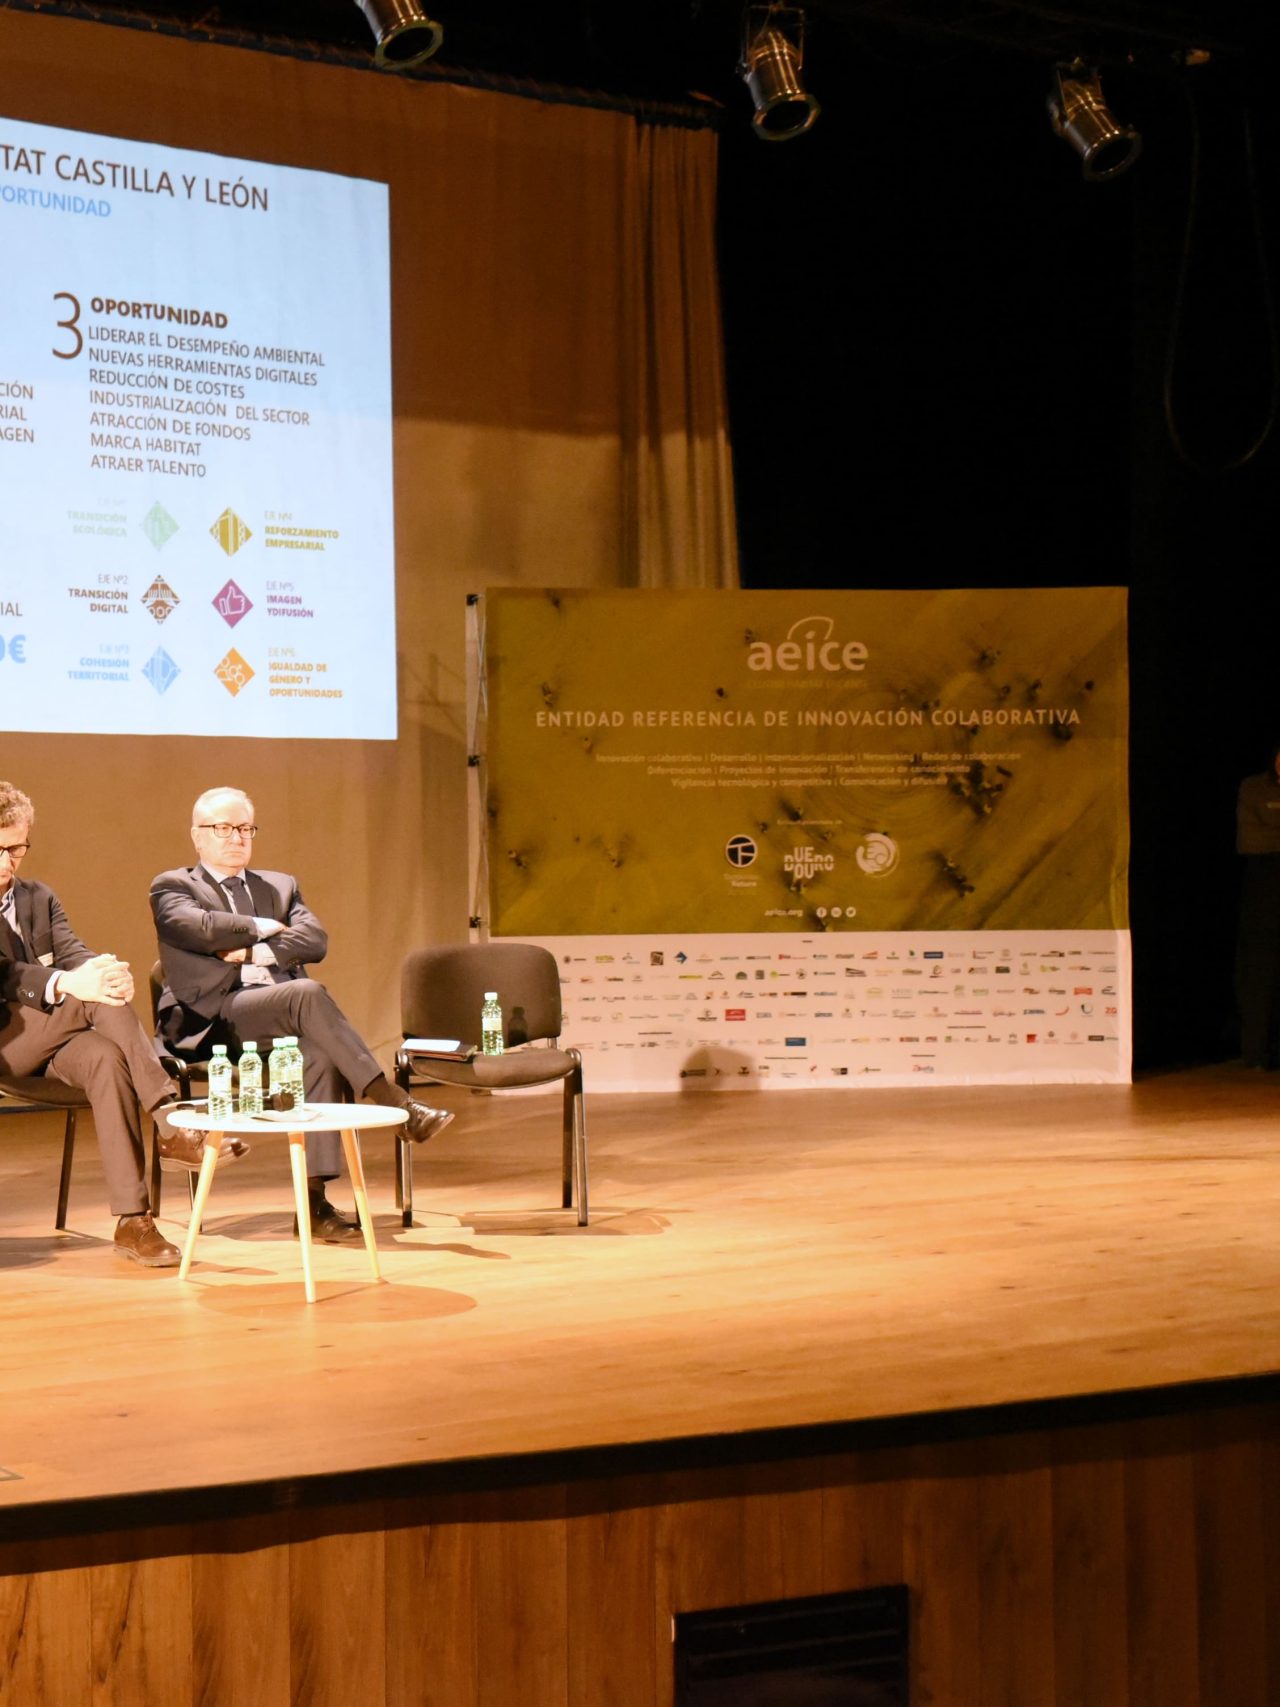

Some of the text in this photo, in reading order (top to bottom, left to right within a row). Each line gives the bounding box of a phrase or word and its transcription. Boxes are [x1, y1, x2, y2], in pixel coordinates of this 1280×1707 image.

[55, 154, 172, 197] CASTILLA
[182, 175, 197, 199] Y
[205, 176, 269, 212] LEÓN
[52, 292, 83, 360] 3
[91, 297, 228, 329] OPORTUNIDAD
[88, 325, 325, 367] LIDERAR EL DESEMPEÑO AMBIENTAL
[89, 347, 318, 386] NUEVAS HERRAMIENTAS DIGITALES
[89, 369, 245, 399] REDUCCIÓN DE COSTES
[89, 390, 310, 425] INDUSTRIALIZACIÓN DEL SECTOR
[90, 412, 251, 441] ATRACCIÓN DE FONDOS
[90, 433, 142, 451] MARCA
[90, 454, 207, 478] ATRAER TALENTO
[68, 587, 128, 600] TRANSICIÓN
[89, 603, 128, 614] DIGITAL
[267, 595, 302, 604] IMAGEN
[747, 629, 869, 671] aeice
[536, 705, 1081, 728] ENTIDAD REFERENCIA DE INNOVACIÓN COLABORATIVA
